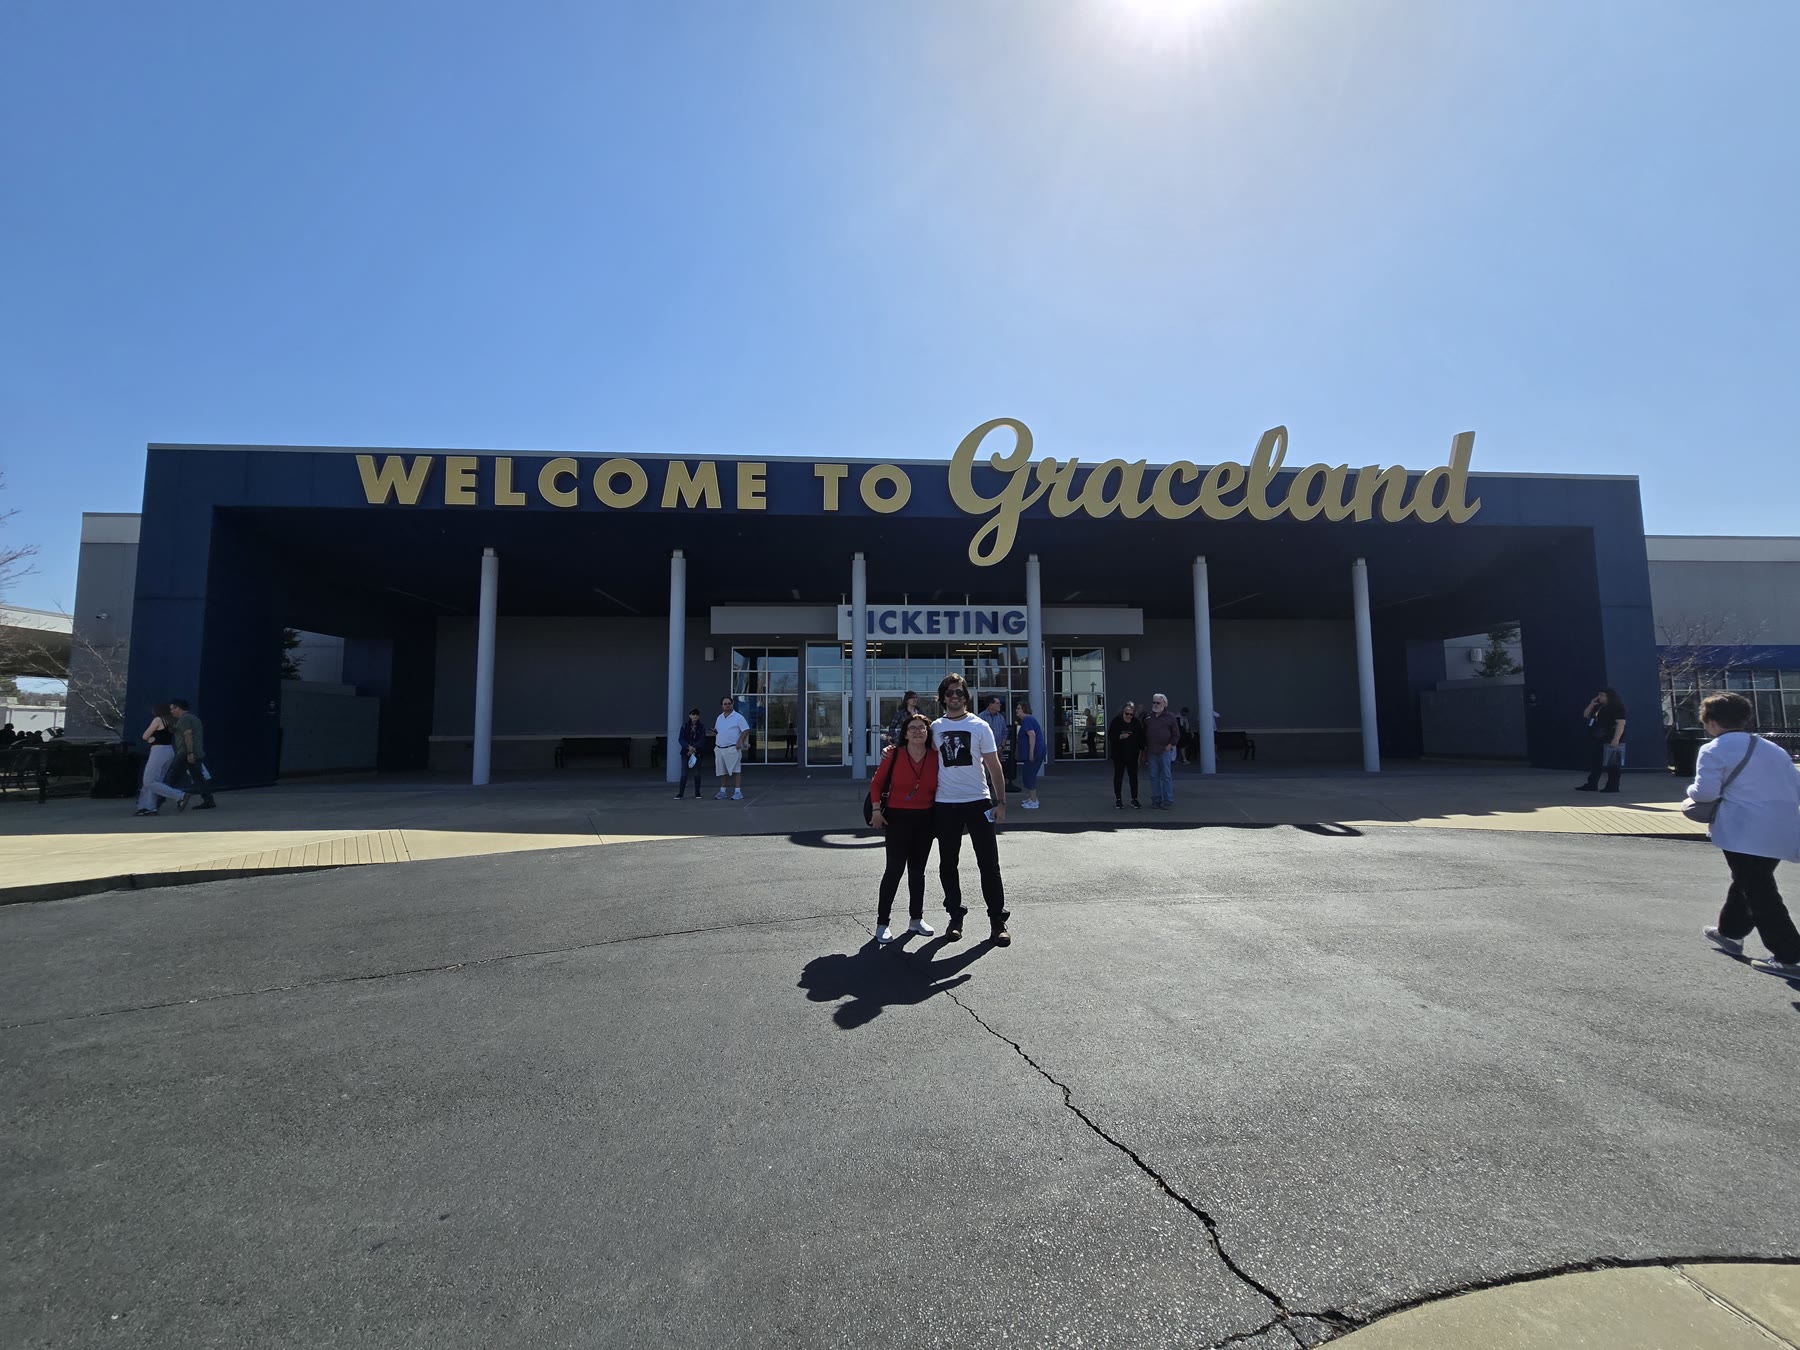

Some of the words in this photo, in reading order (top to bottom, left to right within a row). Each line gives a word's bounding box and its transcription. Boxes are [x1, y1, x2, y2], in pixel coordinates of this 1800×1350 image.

[355, 454, 766, 510] WELCOME
[815, 464, 911, 513] TO
[948, 417, 1481, 566] Graceland
[847, 610, 1026, 635] ICKETING
